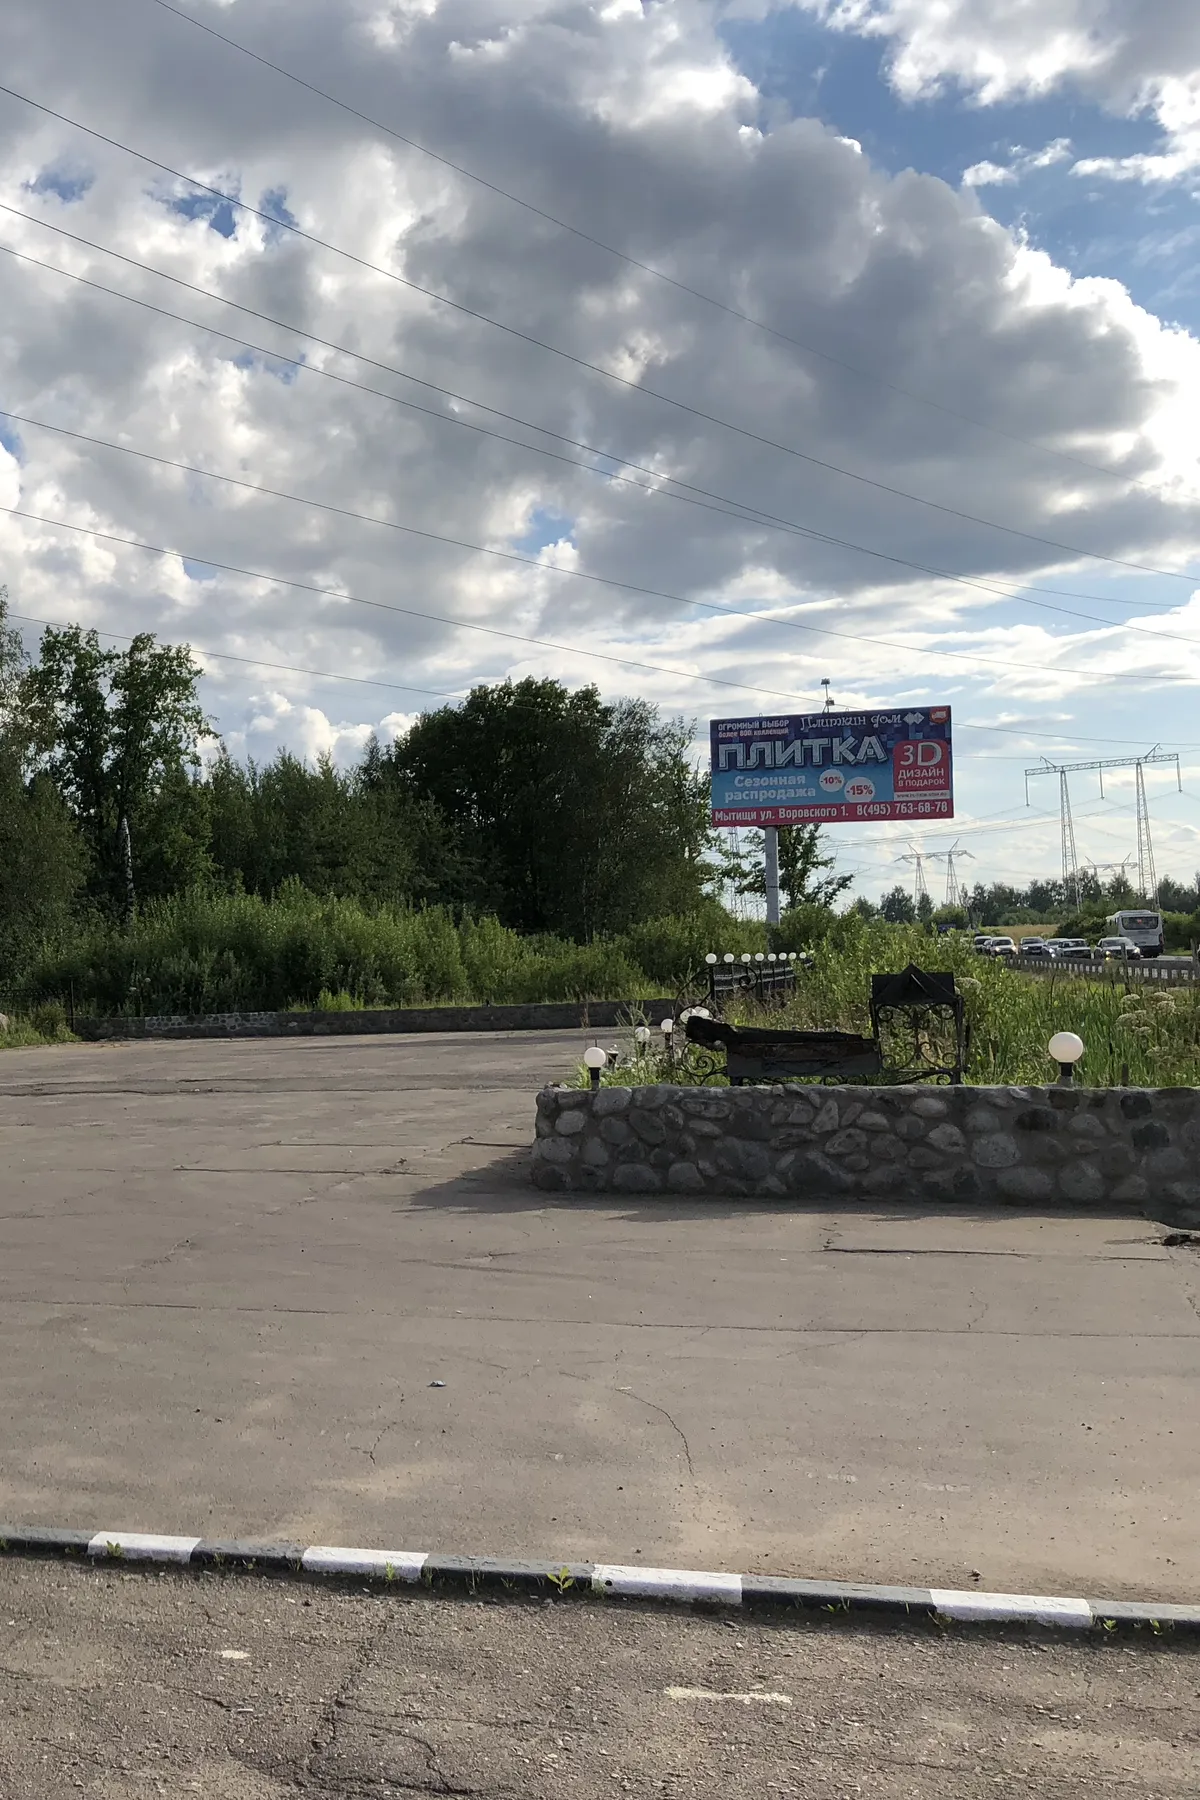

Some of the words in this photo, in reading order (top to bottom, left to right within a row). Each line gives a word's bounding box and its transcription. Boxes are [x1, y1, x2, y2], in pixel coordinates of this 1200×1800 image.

[718, 720, 760, 731] ОГРОМНЫЙ
[762, 719, 790, 728] ВЫБОР
[800, 716, 866, 731] Плиткин
[871, 714, 902, 728] дом
[718, 735, 888, 771] ПЛИТКА
[900, 742, 943, 766] 3D
[898, 766, 944, 780] ДИЗАЙН
[734, 775, 806, 787] Сезонная
[820, 776, 843, 785] -10%
[905, 778, 945, 787] ПОДАРОК
[725, 787, 816, 803] распродажа
[846, 784, 873, 796] -15%
[715, 811, 757, 821] Мытищи
[760, 810, 775, 821] ул.
[778, 807, 837, 819] Воровского
[856, 803, 891, 816] 8(495)
[894, 801, 948, 814] 763-68-78
